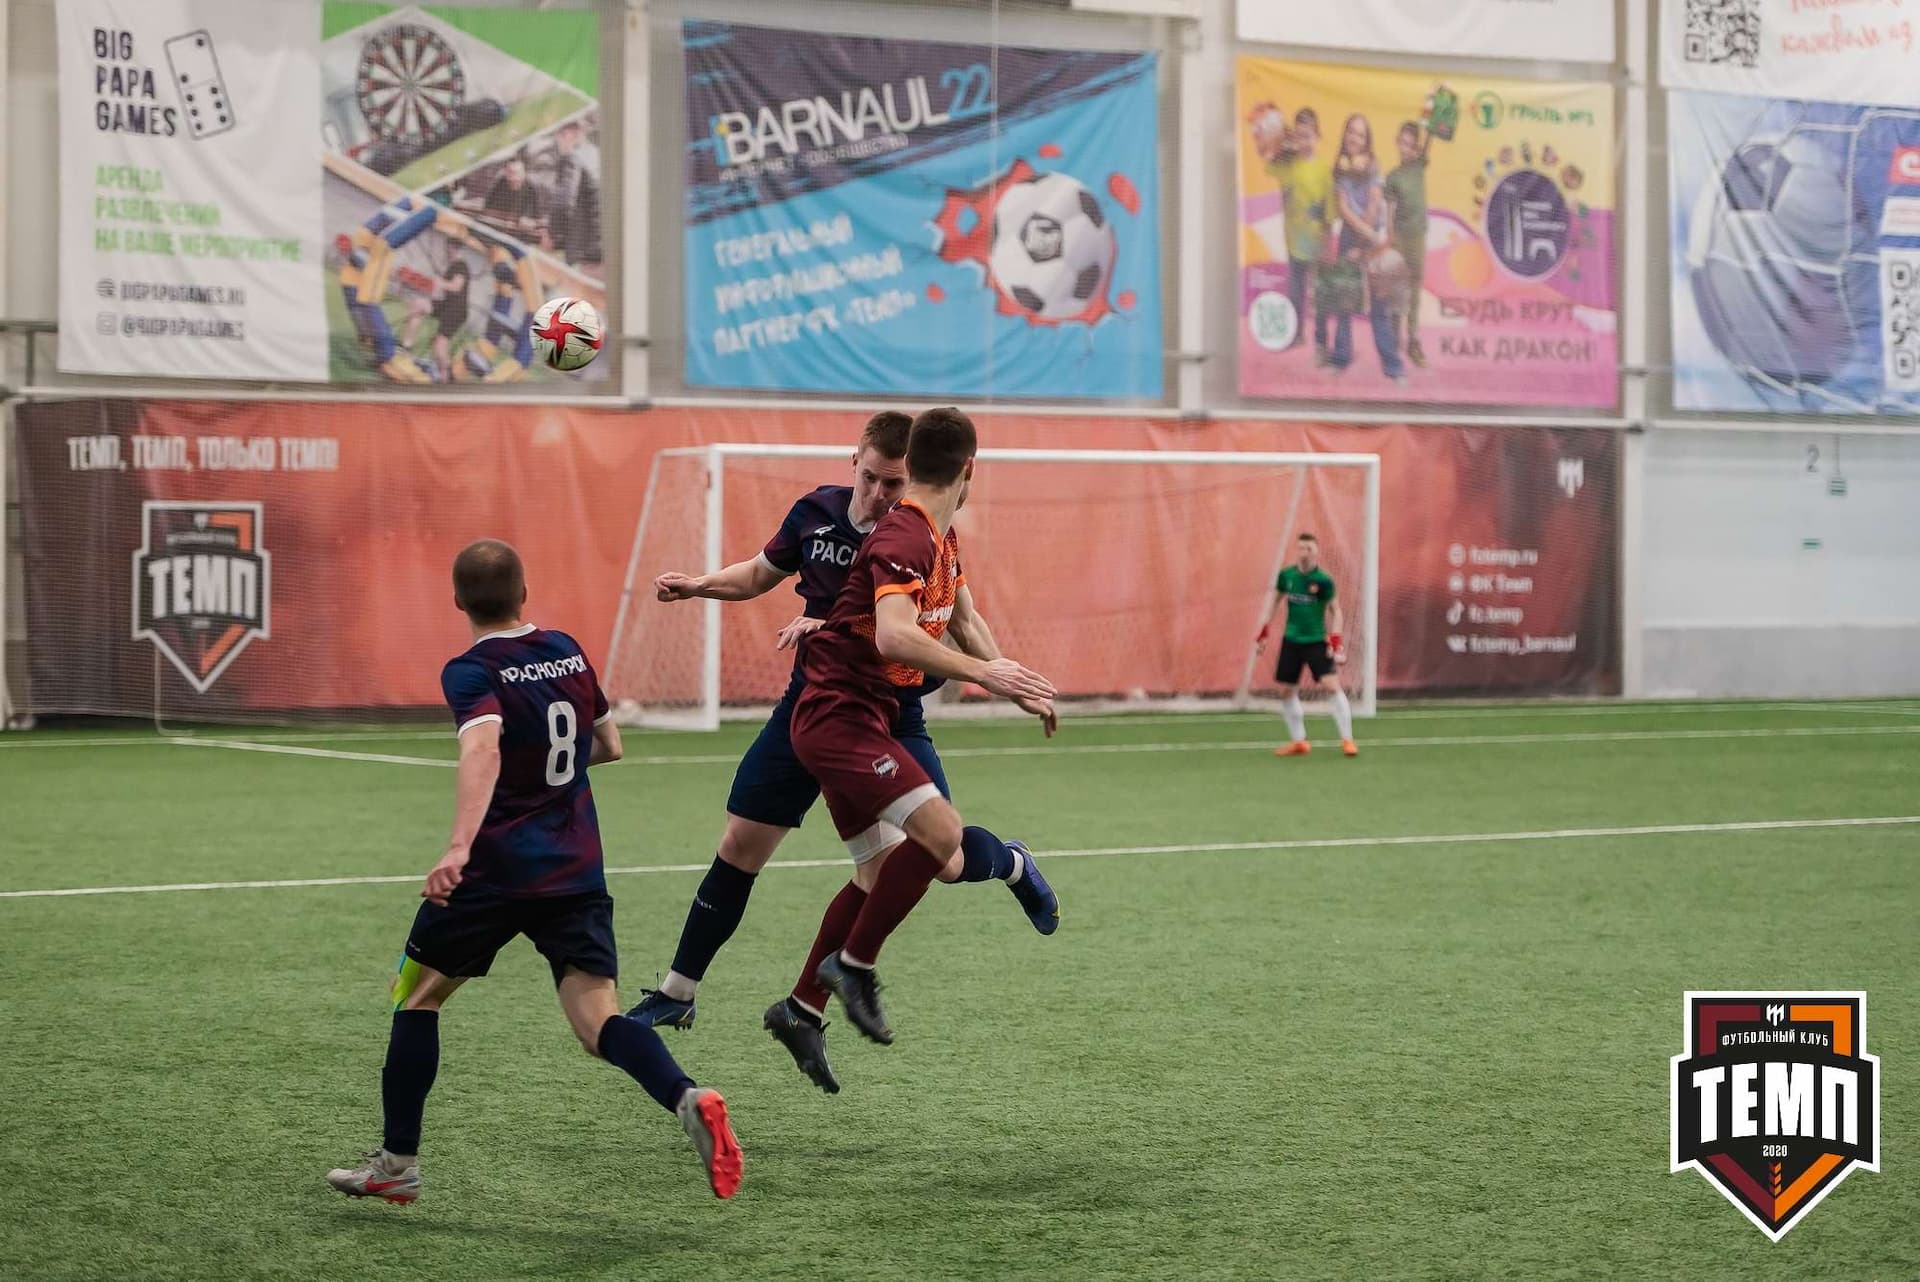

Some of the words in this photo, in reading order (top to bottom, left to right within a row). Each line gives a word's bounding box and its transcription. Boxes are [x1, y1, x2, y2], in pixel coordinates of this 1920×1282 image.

[94, 28, 133, 60] BIG
[96, 66, 155, 99] PAPA
[96, 101, 177, 137] GAMES
[1440, 335, 1488, 357] КАК
[197, 435, 275, 471] ТОЛЬКО
[148, 554, 257, 620] ТЕМП
[545, 700, 577, 787] 8
